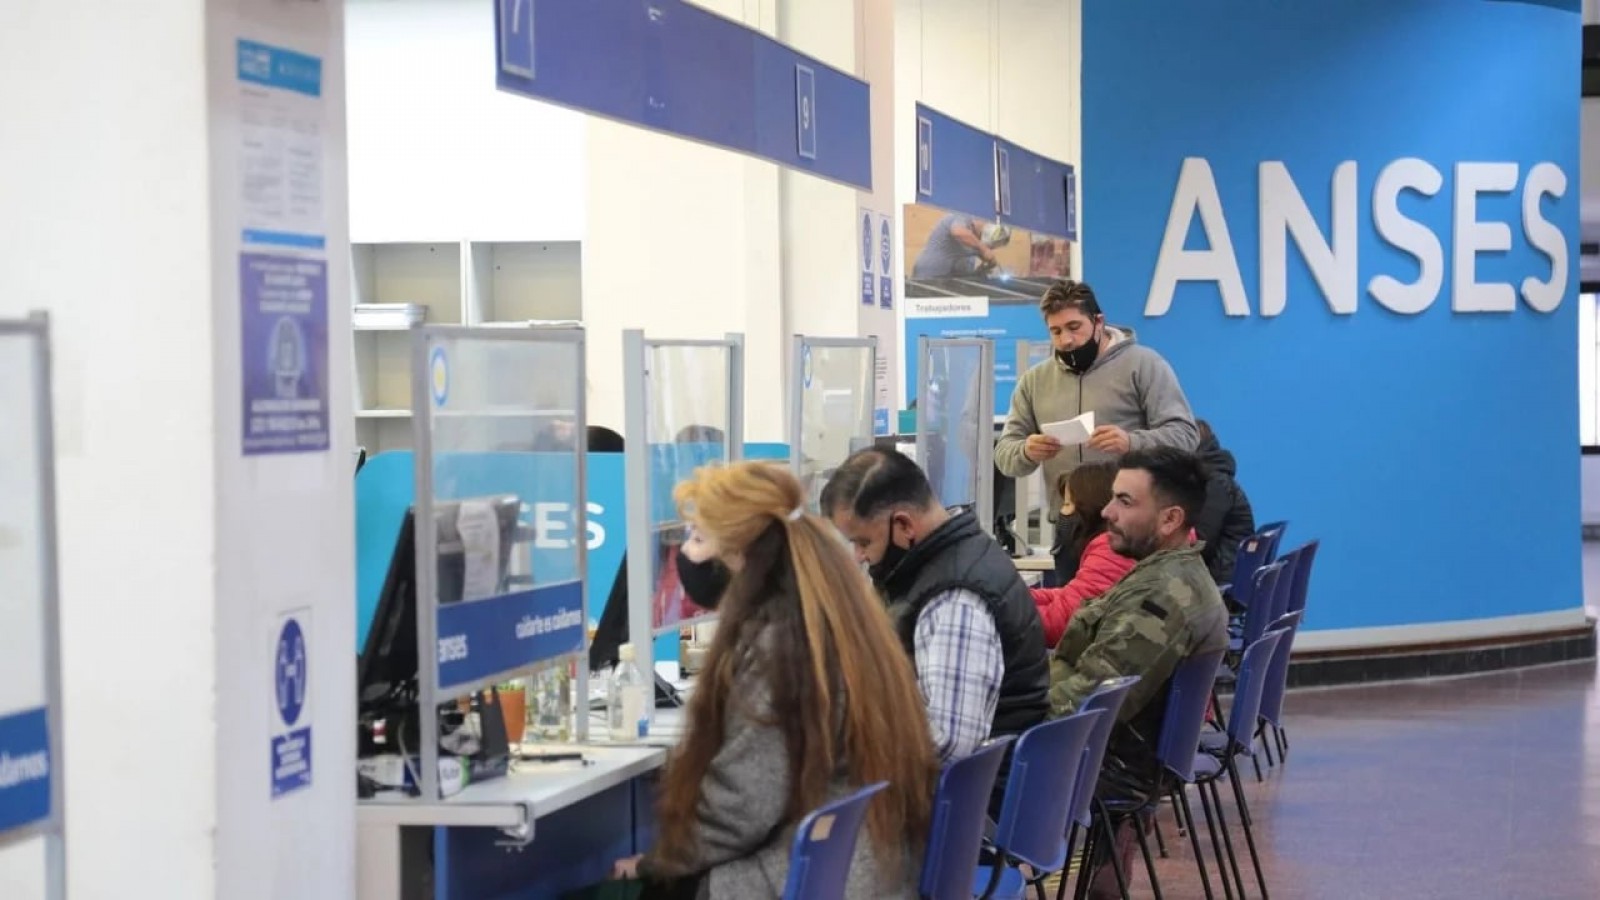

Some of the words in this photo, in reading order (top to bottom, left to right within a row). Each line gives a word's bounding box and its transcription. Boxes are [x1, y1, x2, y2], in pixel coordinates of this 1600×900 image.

[802, 95, 810, 130] 9
[1144, 156, 1568, 316] ANSES
[518, 502, 606, 551] ES
